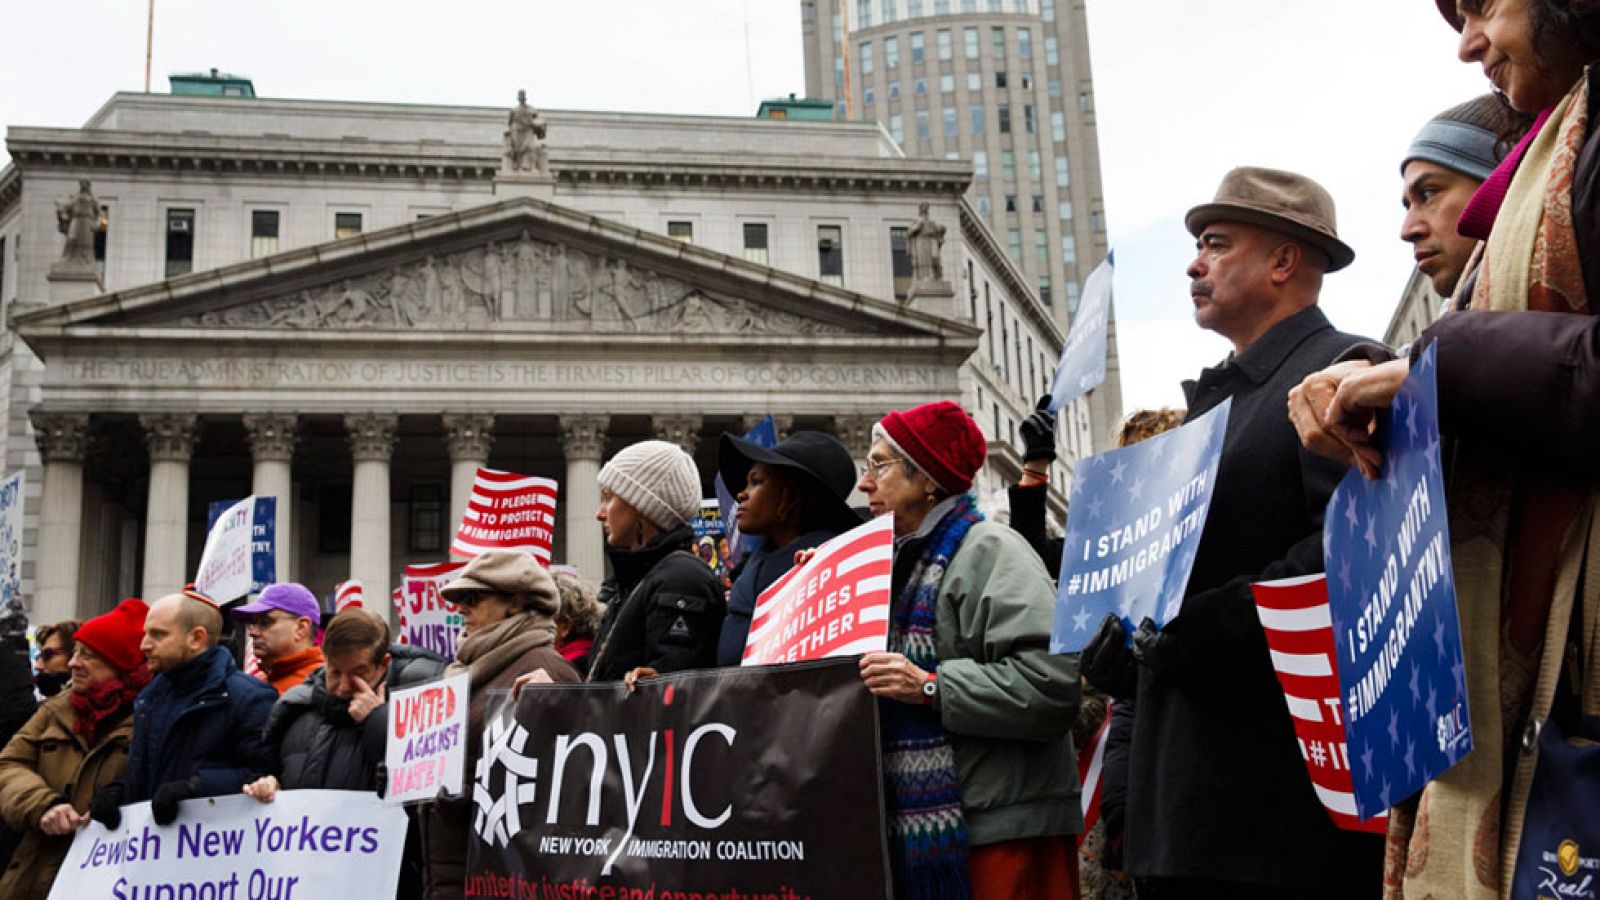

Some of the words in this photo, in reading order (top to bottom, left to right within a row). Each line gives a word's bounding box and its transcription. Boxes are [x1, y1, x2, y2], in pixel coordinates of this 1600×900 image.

[69, 359, 106, 380] THE
[118, 360, 169, 380] TRUE
[178, 361, 351, 382] ADMINISTRATION
[361, 363, 389, 382] OF
[396, 363, 479, 383] JUSTICE
[487, 364, 504, 383] IS
[510, 365, 547, 383] THE
[556, 365, 634, 384] FIRMEST
[644, 365, 704, 384] PILLAR
[711, 366, 738, 385] OF
[744, 366, 802, 385] GOOD
[810, 366, 941, 385] GOVERNMENT
[481, 513, 497, 525] TO
[500, 510, 543, 525] PROTECT
[501, 494, 539, 508] PLEDGE
[1083, 539, 1091, 561] I
[1096, 507, 1162, 558] STAND
[1168, 470, 1207, 519] WITH
[1067, 502, 1206, 596] #IMMIGRANTNY
[1348, 628, 1356, 663] I
[1357, 552, 1399, 654] STAND
[1397, 474, 1431, 567] WITH
[1348, 530, 1446, 723] #IMMIGRANTNY
[395, 686, 456, 740] UNITED
[403, 722, 460, 763] AGAINST
[391, 756, 447, 797] HATE!
[80, 825, 161, 869] Jewish
[177, 822, 245, 858] New
[255, 815, 379, 854] Yorkers
[539, 836, 573, 854] NEW
[573, 838, 612, 856] YORK
[627, 839, 710, 860] IMMIGRATION
[717, 840, 805, 860] COALITION
[112, 871, 239, 900] Support
[248, 868, 300, 900] Our
[464, 869, 514, 897] united
[516, 872, 538, 899] for
[538, 875, 616, 900] justice
[620, 879, 656, 900] and
